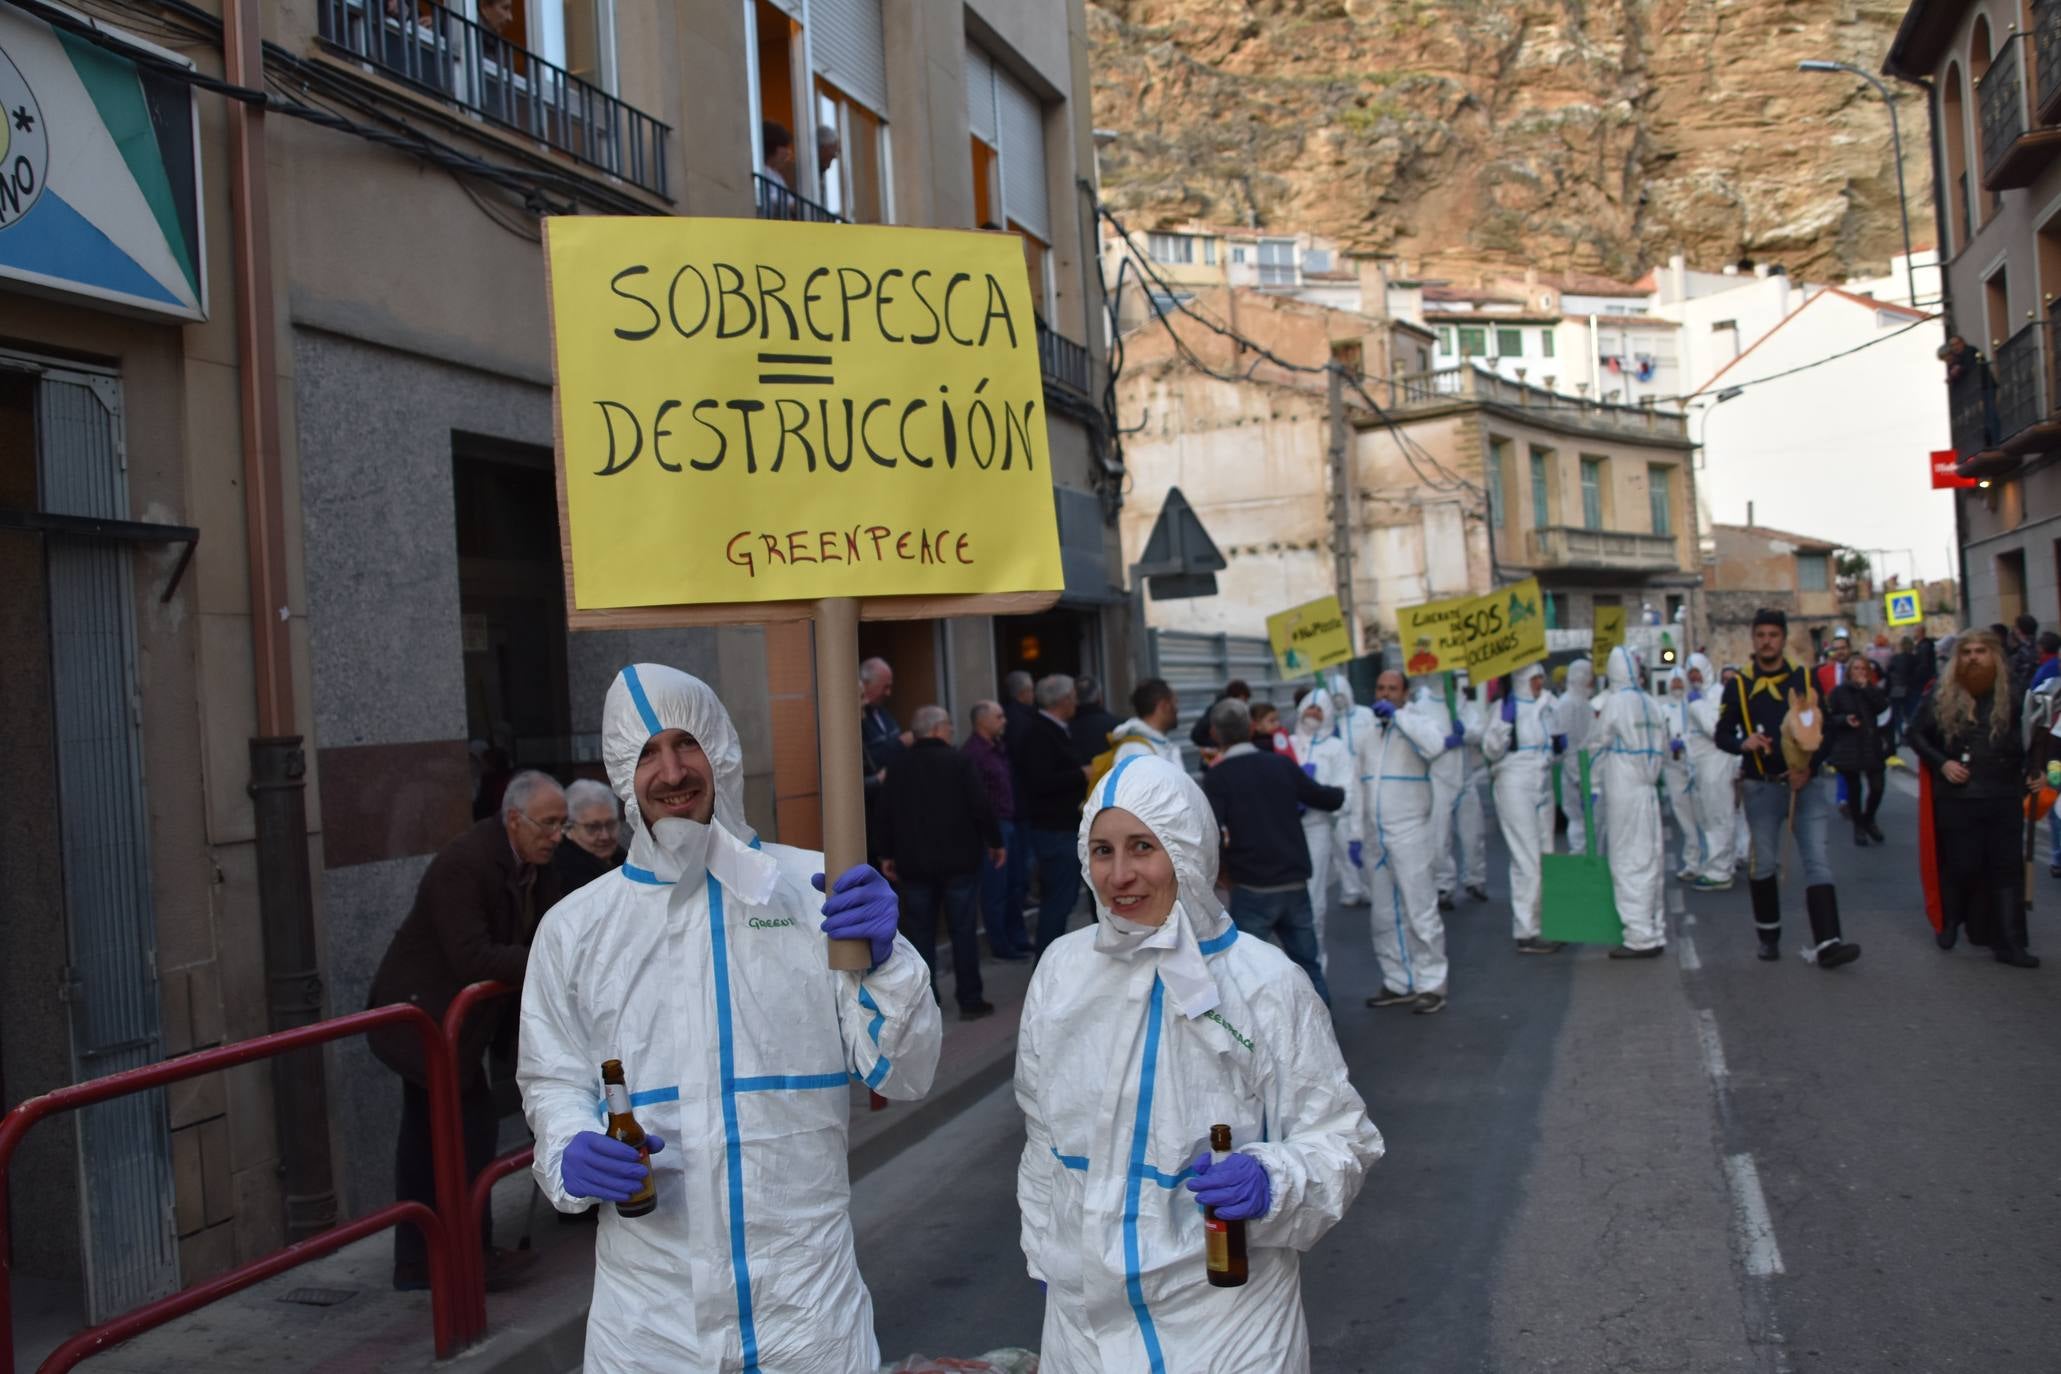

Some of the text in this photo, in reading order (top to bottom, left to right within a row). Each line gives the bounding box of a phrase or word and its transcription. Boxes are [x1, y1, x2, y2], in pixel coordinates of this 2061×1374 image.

[0, 155, 35, 223] NO
[610, 263, 1018, 349] SOBREPESCA
[725, 524, 975, 578] GREENPEACE
[1464, 603, 1503, 642] SOS
